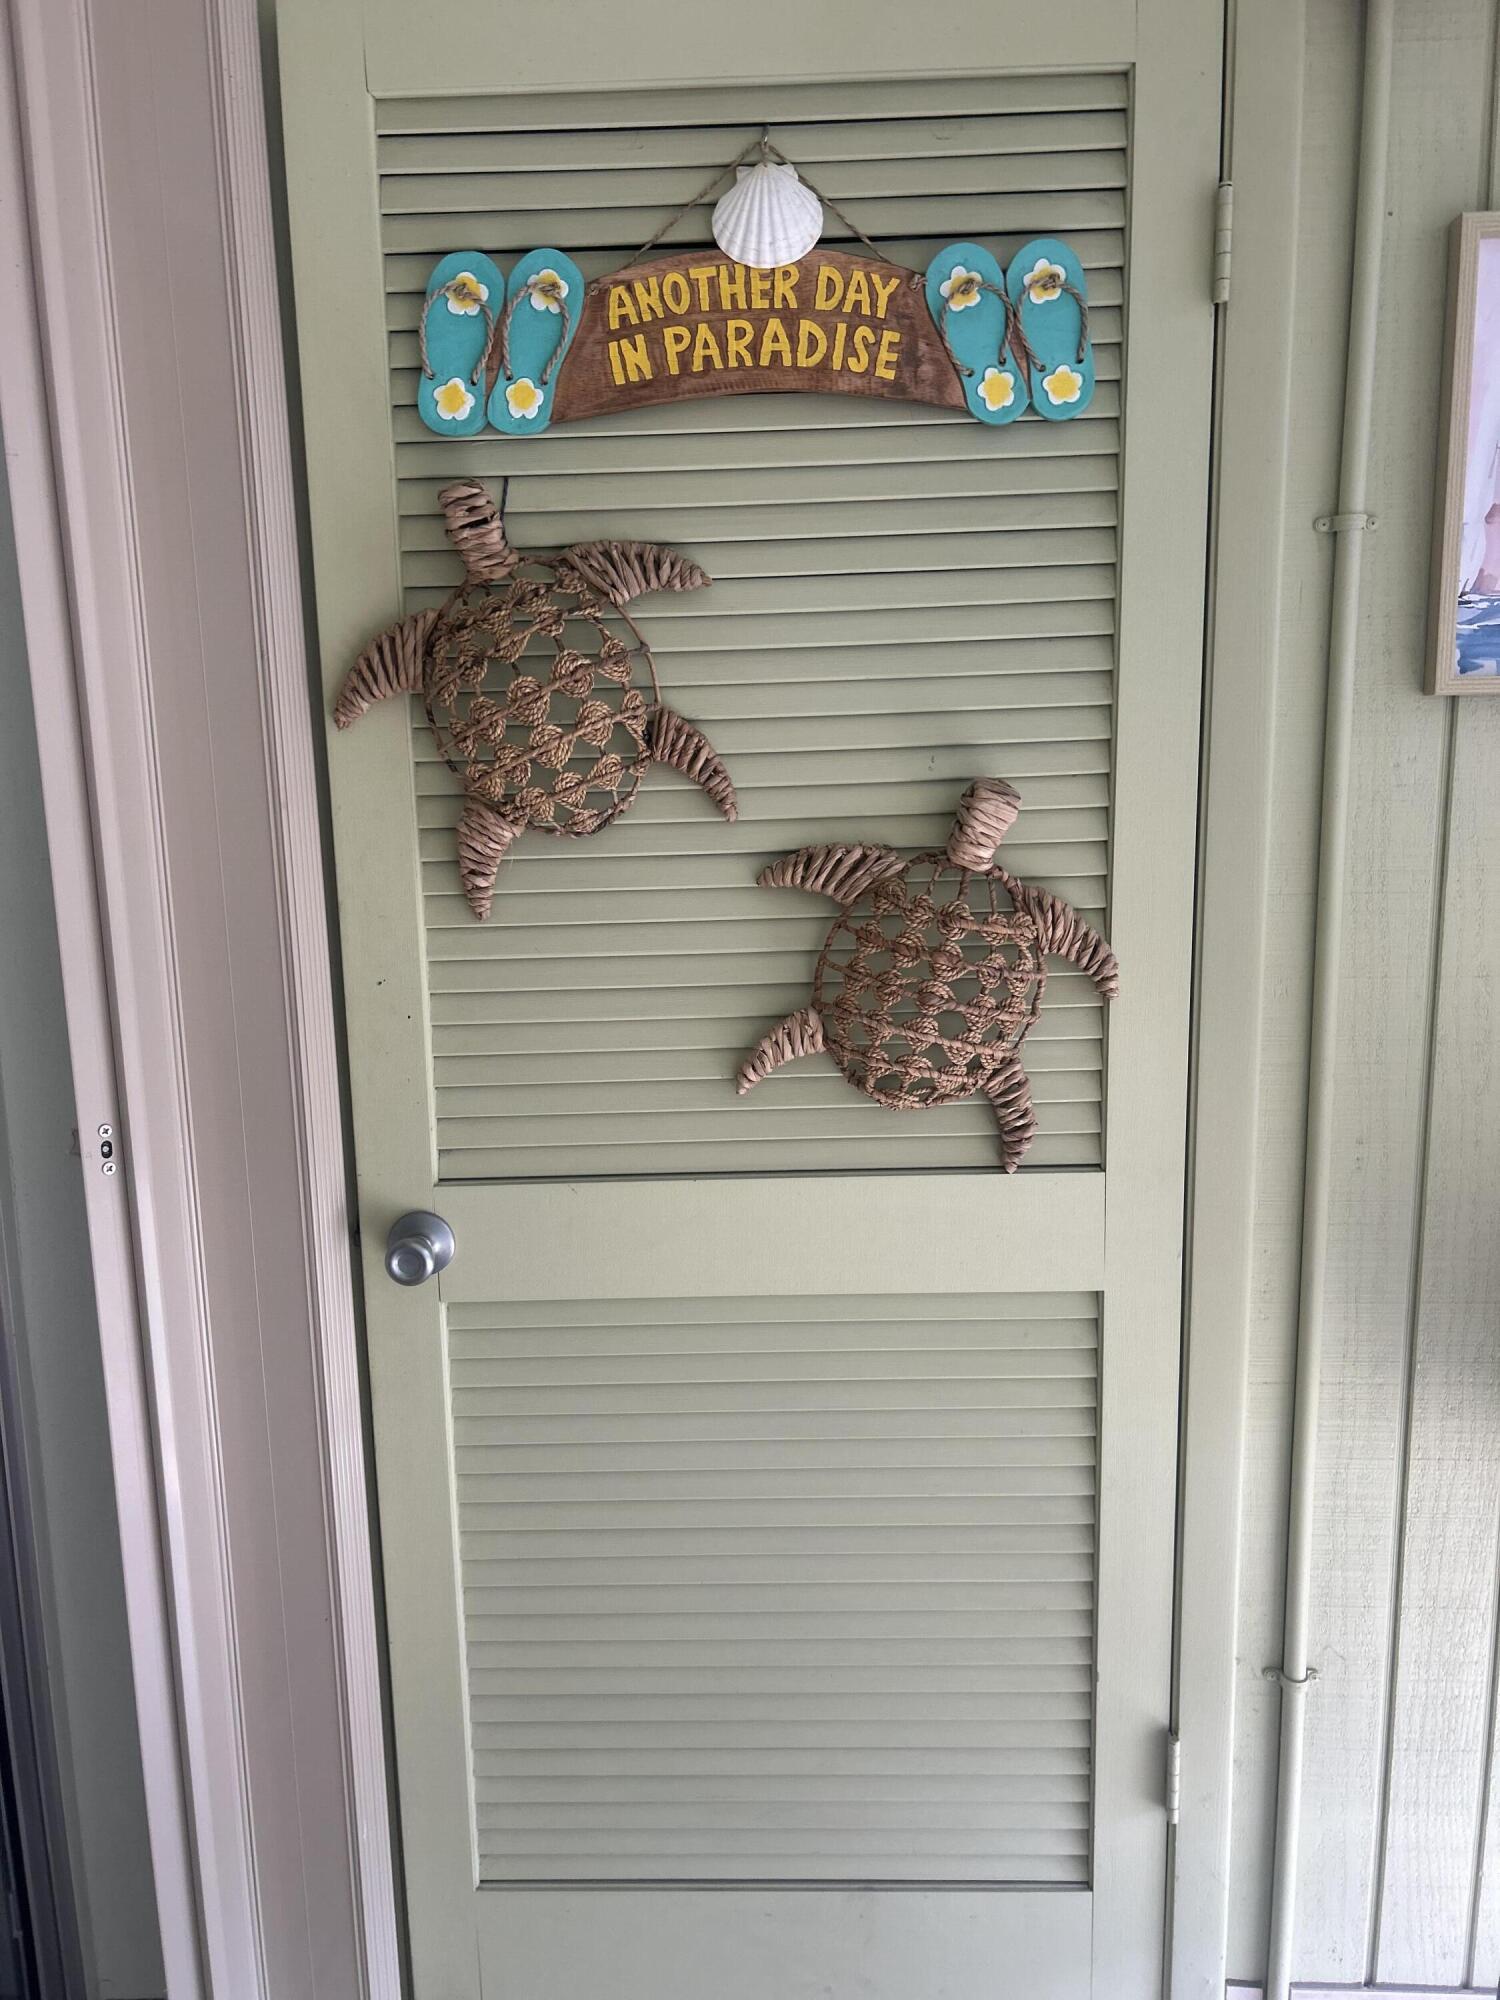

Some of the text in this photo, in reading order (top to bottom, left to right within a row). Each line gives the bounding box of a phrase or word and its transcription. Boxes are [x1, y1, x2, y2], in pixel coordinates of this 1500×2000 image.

[608, 264, 900, 330] ANOTHER DAY
[608, 318, 901, 385] IN PARADISE
